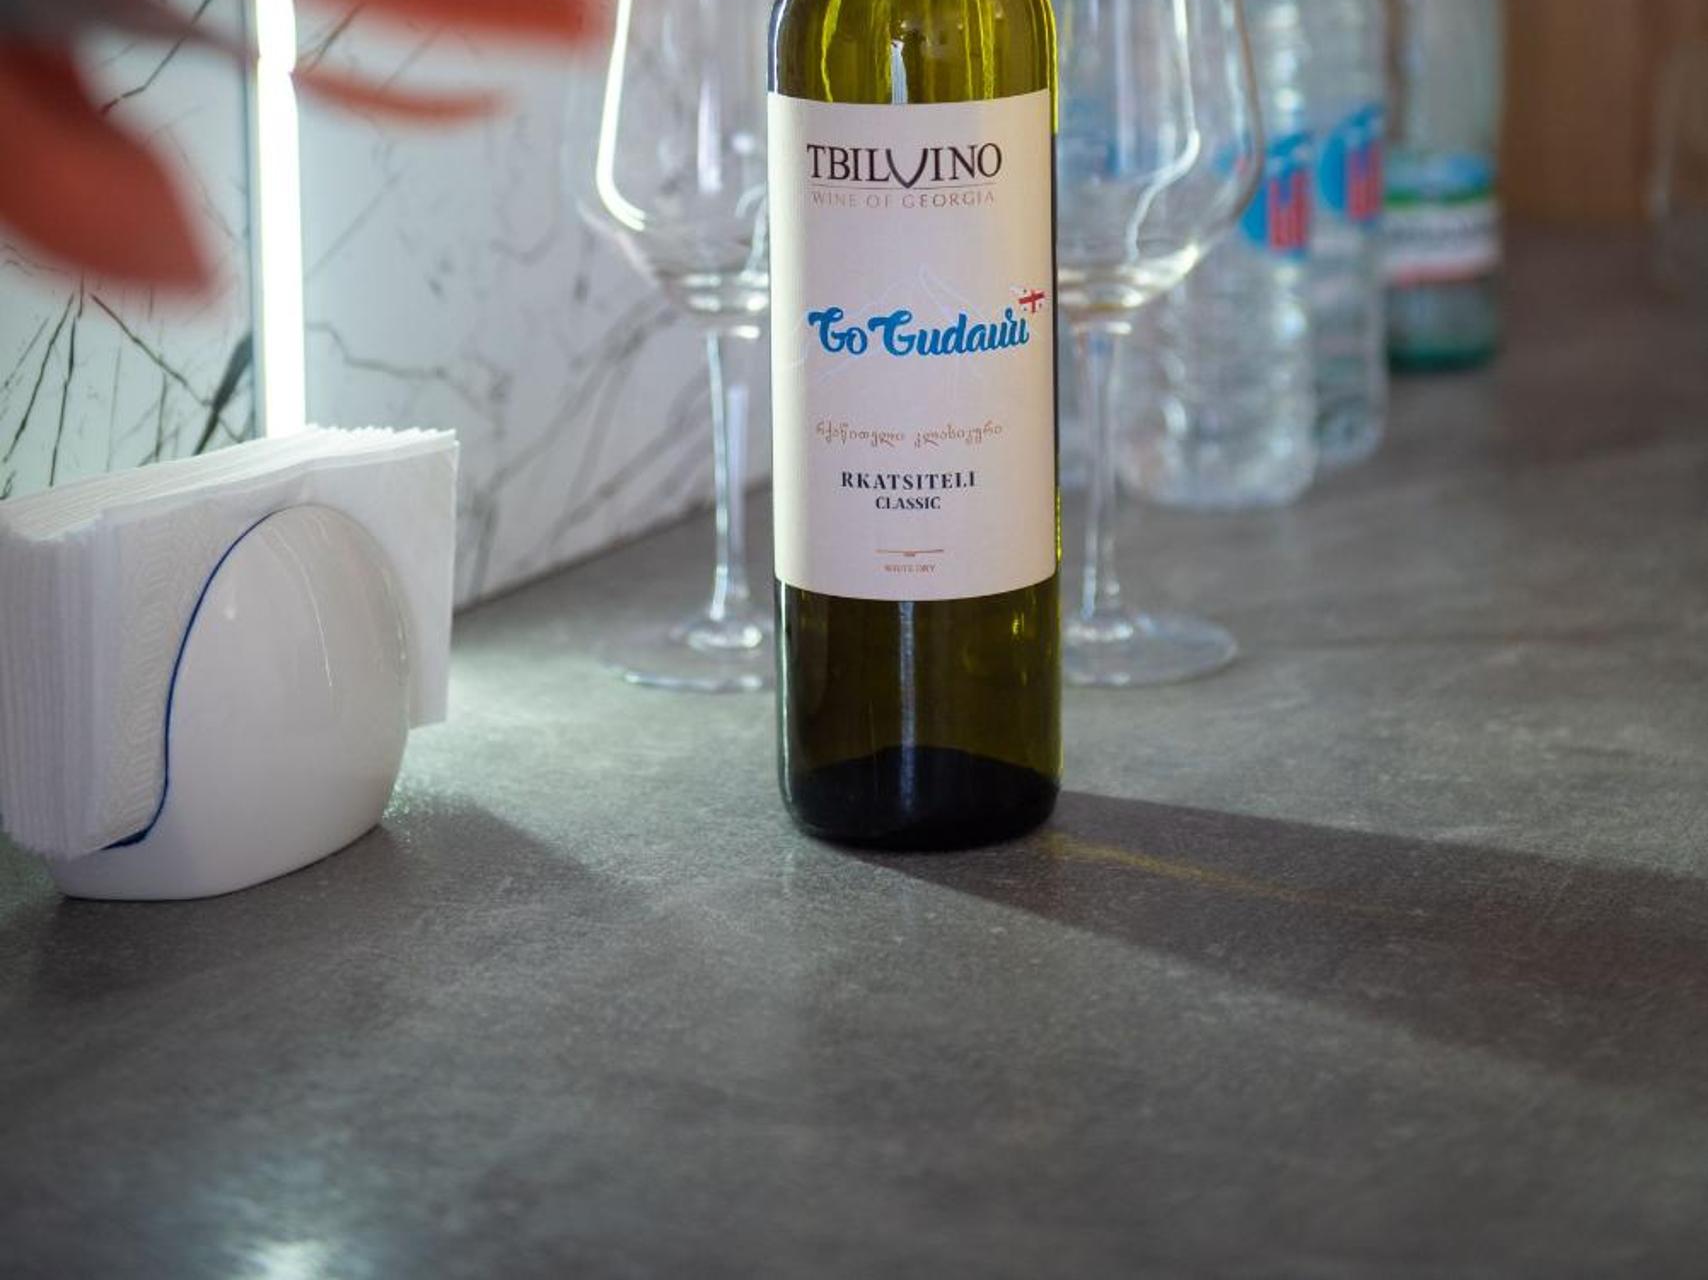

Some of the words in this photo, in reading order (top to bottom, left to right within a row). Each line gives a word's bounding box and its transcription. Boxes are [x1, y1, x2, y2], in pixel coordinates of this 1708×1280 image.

[806, 142, 1002, 188] TBILVINO
[811, 191, 858, 208] WINE
[902, 191, 995, 208] GEORGIA
[808, 306, 868, 355] Go
[868, 308, 1030, 356] Gudauri
[841, 471, 976, 490] RKATSITELI
[875, 496, 941, 509] CLASSIC
